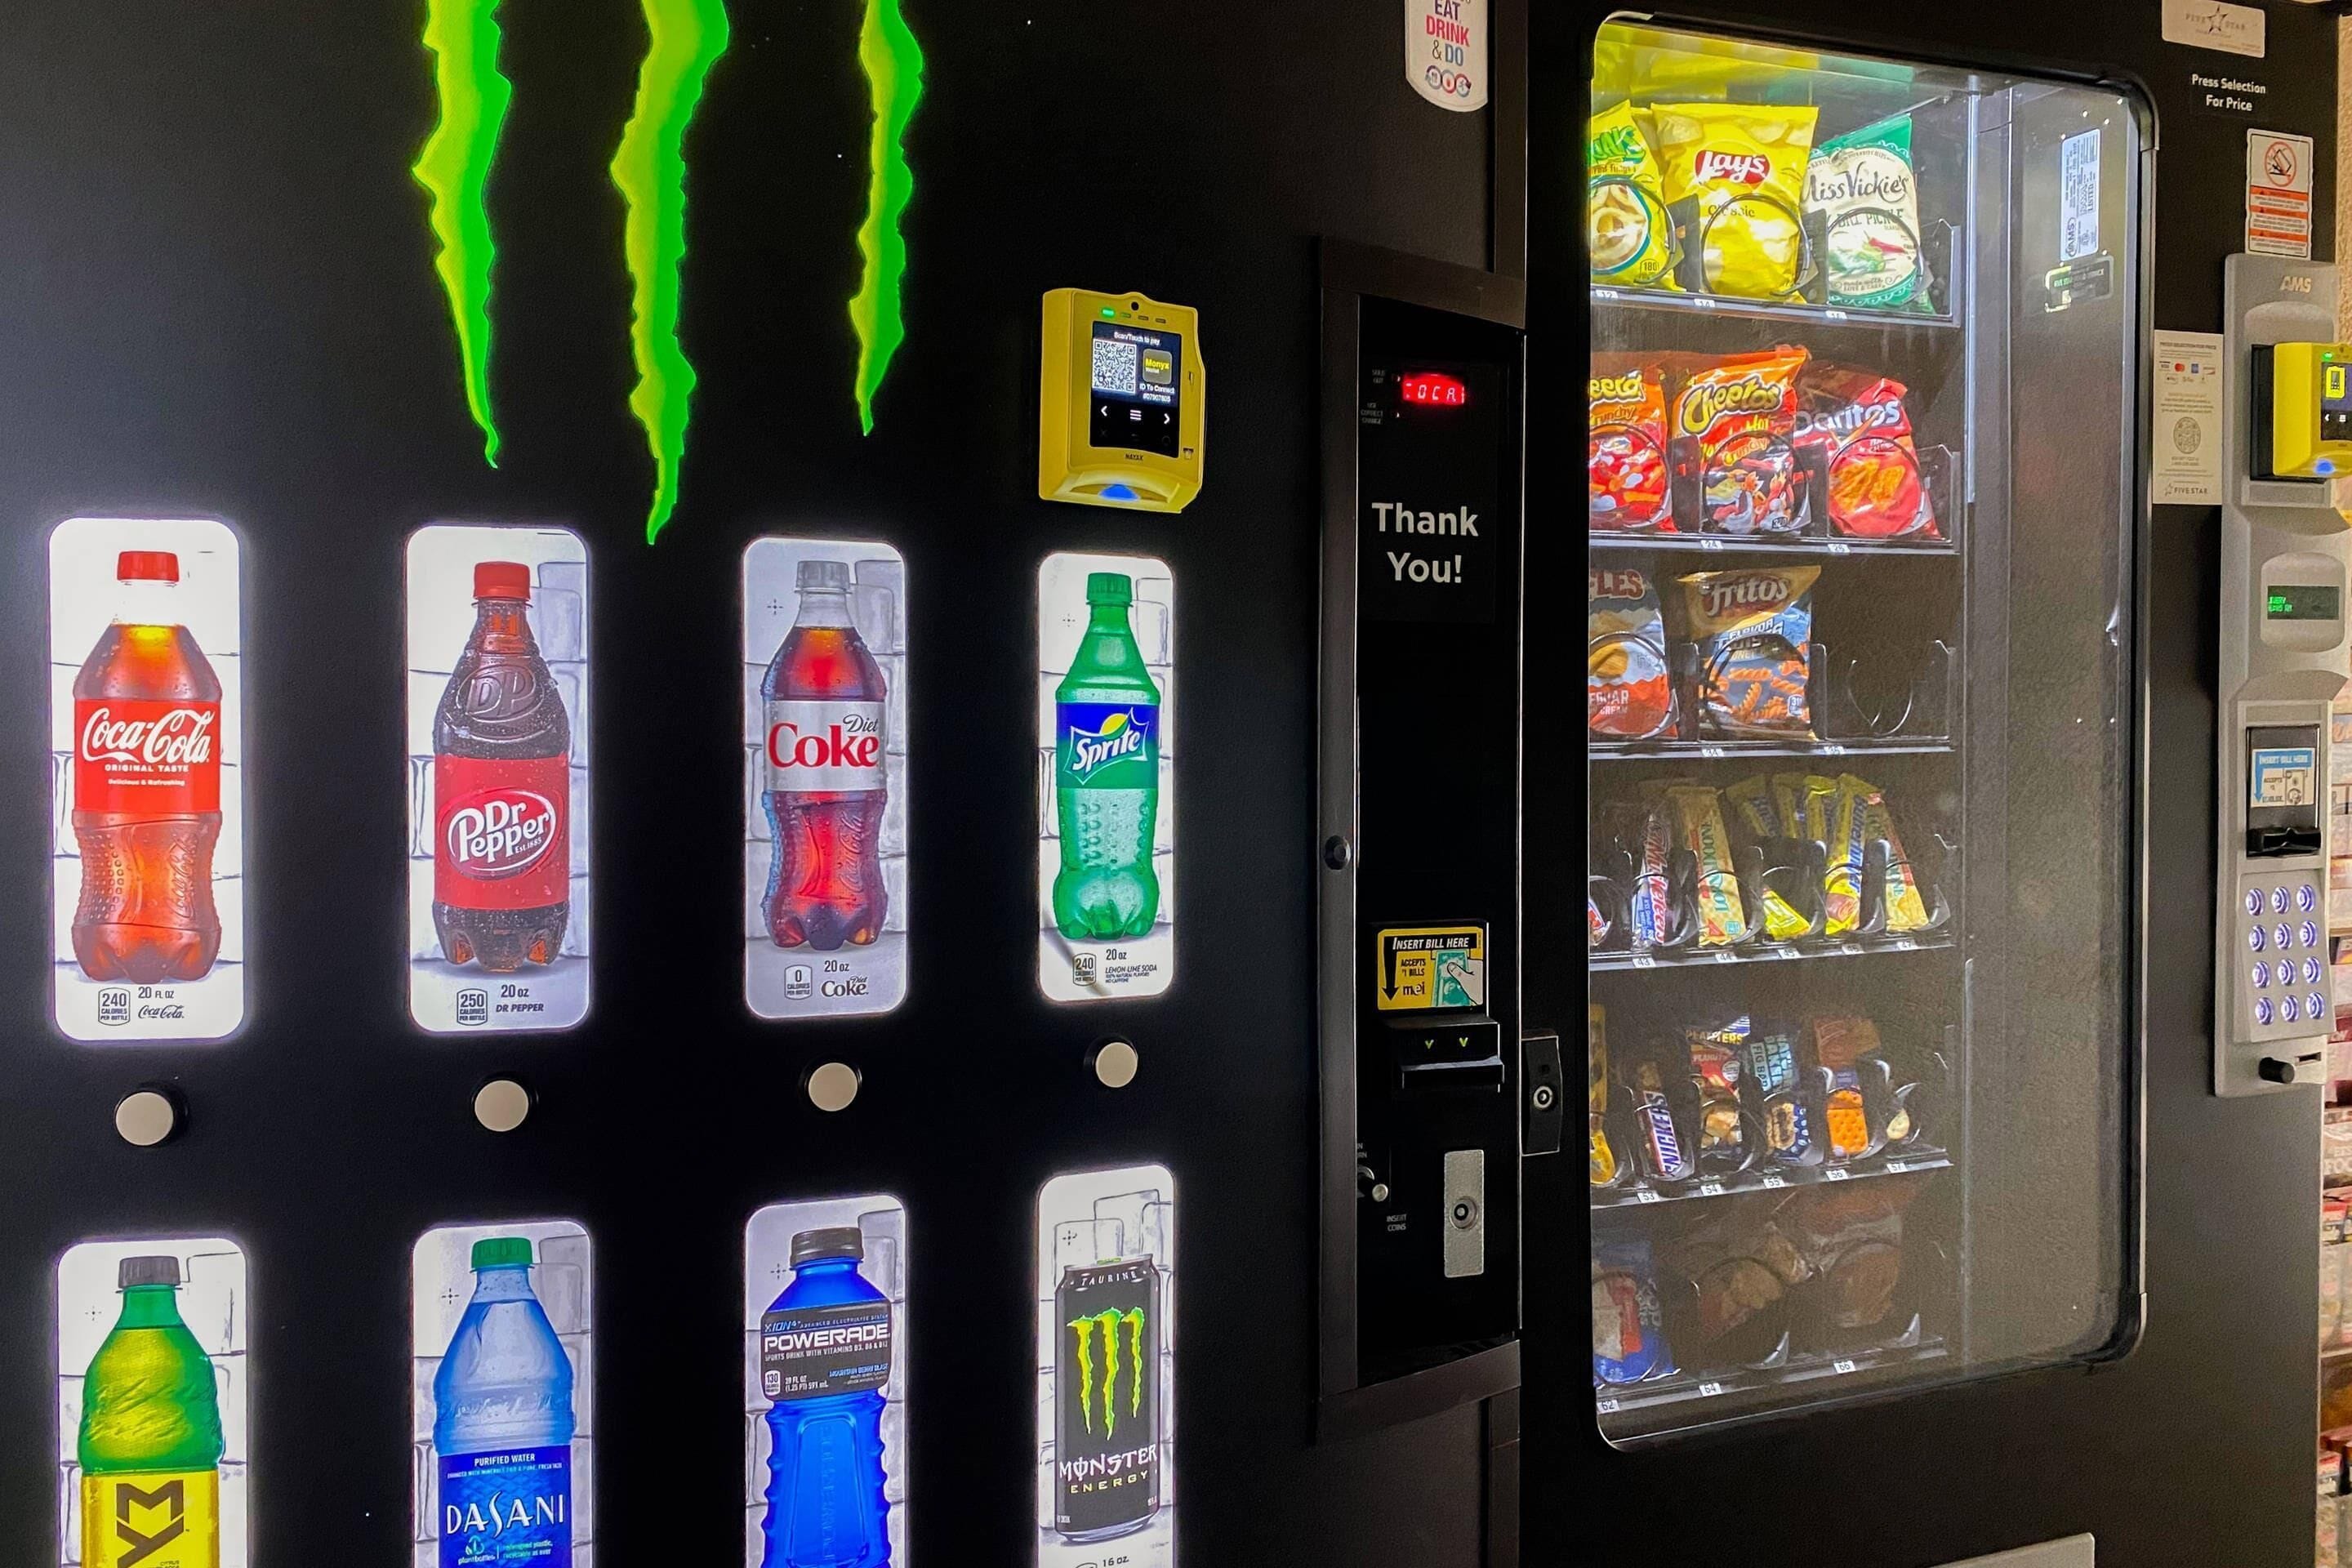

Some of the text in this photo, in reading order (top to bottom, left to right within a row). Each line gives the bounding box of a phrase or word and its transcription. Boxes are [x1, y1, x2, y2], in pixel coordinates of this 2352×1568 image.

[1426, 15, 1469, 47] DRINK
[1432, 40, 1463, 66] & DO
[2191, 74, 2266, 95] Press Selection
[2206, 95, 2252, 112] For Price
[1696, 151, 1766, 185] Lay's
[1834, 161, 1909, 203] Vickie's
[1643, 261, 1657, 271] 180
[2280, 275, 2311, 292] AMS
[1145, 358, 1169, 370] Monyx
[1681, 377, 1782, 434] Cheetos
[1722, 437, 1771, 466] Crunchy
[1372, 502, 1479, 537] Thank
[1387, 551, 1462, 584] You!
[1705, 577, 1789, 617] Fritos
[843, 714, 879, 733] Diet
[82, 707, 215, 764] Coca-Cola
[768, 722, 880, 768] Coke
[1072, 724, 1140, 773] Sprite
[105, 764, 189, 773] ORIGINAL TASTE
[484, 800, 528, 826] Dr
[458, 807, 550, 863] Pepper
[1392, 937, 1469, 950] INSERT BILL HERE
[1106, 949, 1116, 960] 20
[824, 960, 837, 972] 20
[1076, 957, 1094, 970] 240
[1106, 965, 1125, 973] LEMON
[1401, 958, 1426, 967] ACCEPTS
[1637, 958, 1650, 967] 43
[795, 969, 802, 982] 0
[1409, 968, 1425, 977] BILLS
[138, 987, 151, 999] 20
[501, 985, 515, 998] 20
[821, 980, 869, 997] Coke
[1402, 982, 1425, 996] mei
[102, 993, 127, 1007] 240
[461, 994, 484, 1008] 250
[496, 1004, 544, 1013] DR PEPPER
[1831, 1169, 1843, 1178] 56
[1706, 1184, 1718, 1194] 54
[1768, 1178, 1780, 1187] 55
[1643, 1192, 1655, 1200] 53
[1386, 1214, 1406, 1222] INSERT
[1082, 1271, 1137, 1286] TAURINE
[764, 1323, 889, 1352] POWERADE
[764, 1352, 785, 1361] SPORTS
[786, 1352, 804, 1360] DRINK
[806, 1348, 822, 1356] WITH
[823, 1345, 853, 1355] VITAMINS
[767, 1373, 778, 1383] 130
[1601, 1401, 1615, 1410] 62
[474, 1453, 536, 1467] PURIFIED WATER
[1071, 1469, 1148, 1494] ENERGY
[447, 1490, 564, 1539] DASANI
[1102, 1557, 1114, 1567] 16
